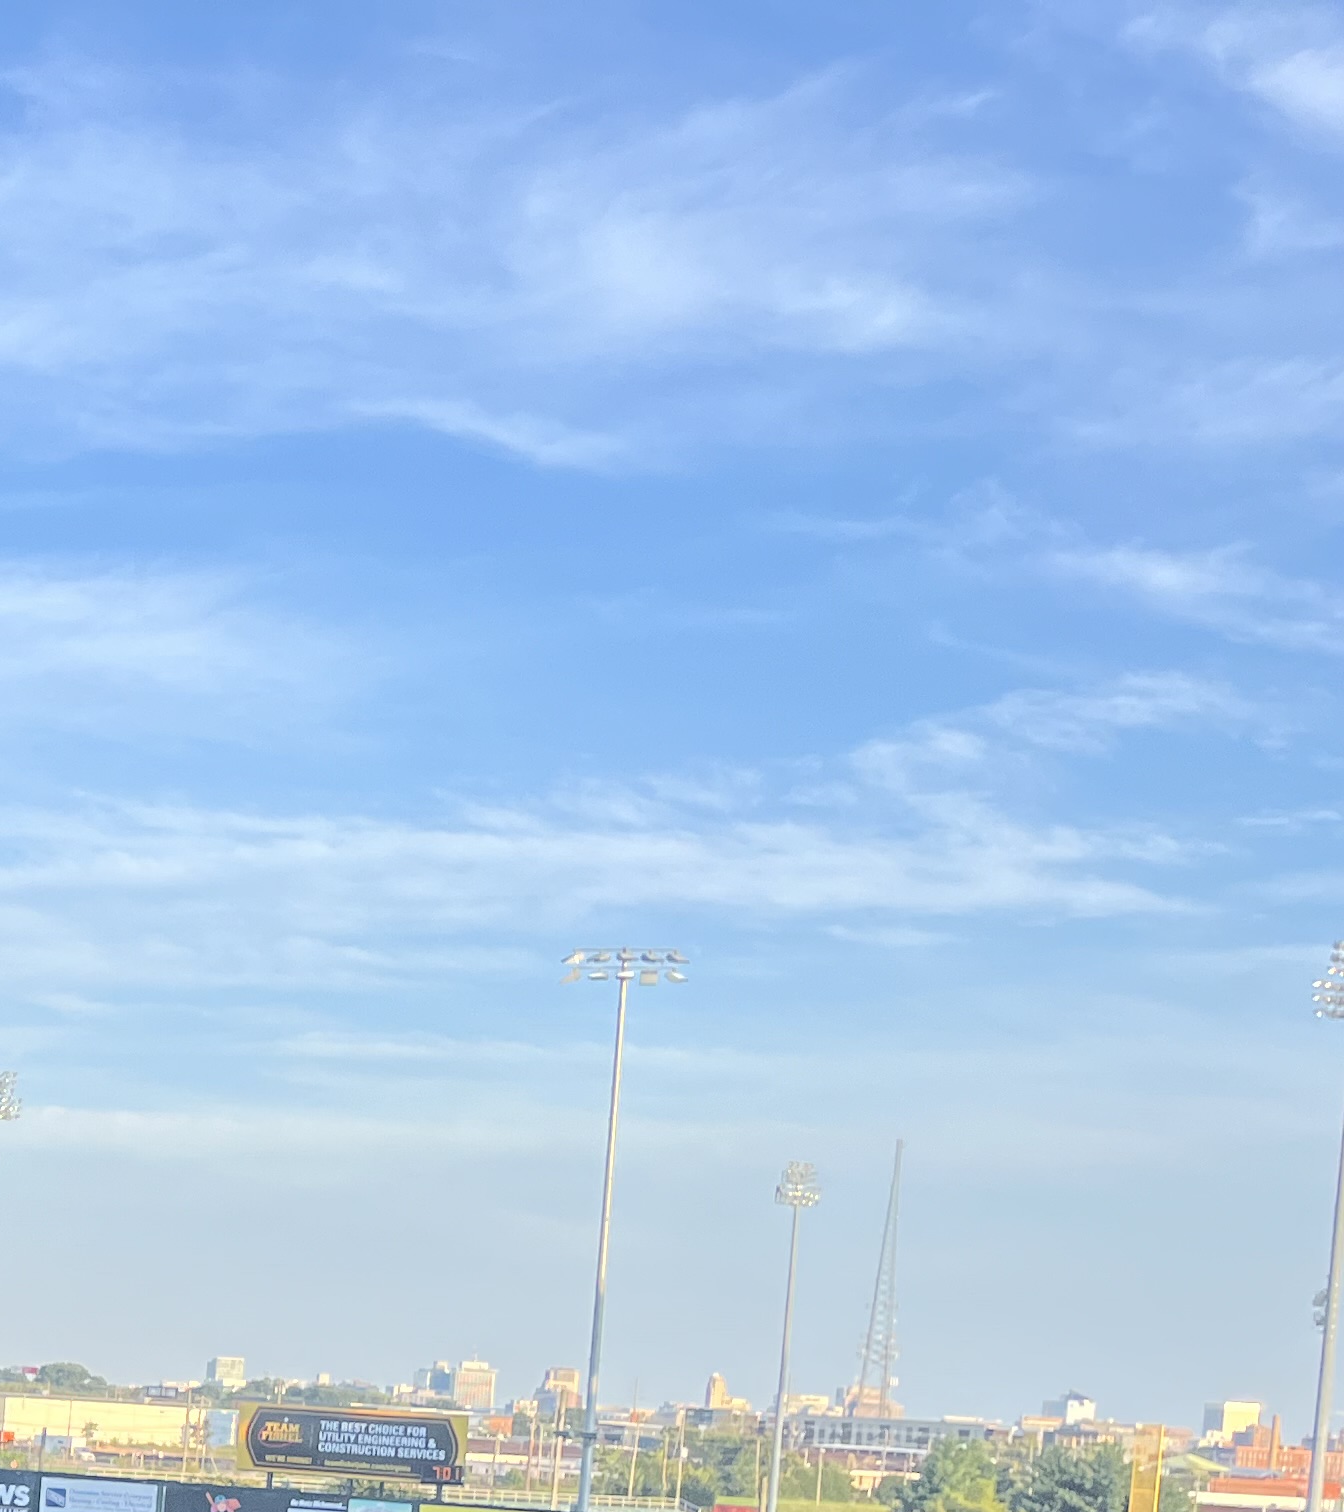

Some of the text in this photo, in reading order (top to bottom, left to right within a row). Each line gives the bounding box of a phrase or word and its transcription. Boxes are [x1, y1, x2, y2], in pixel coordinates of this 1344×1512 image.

[320, 1420, 427, 1437] THE BEST CHOICE FOR
[318, 1430, 436, 1448] UTILITY ENGINEERING &
[318, 1443, 445, 1461] CONSTRUCTION SERVICES
